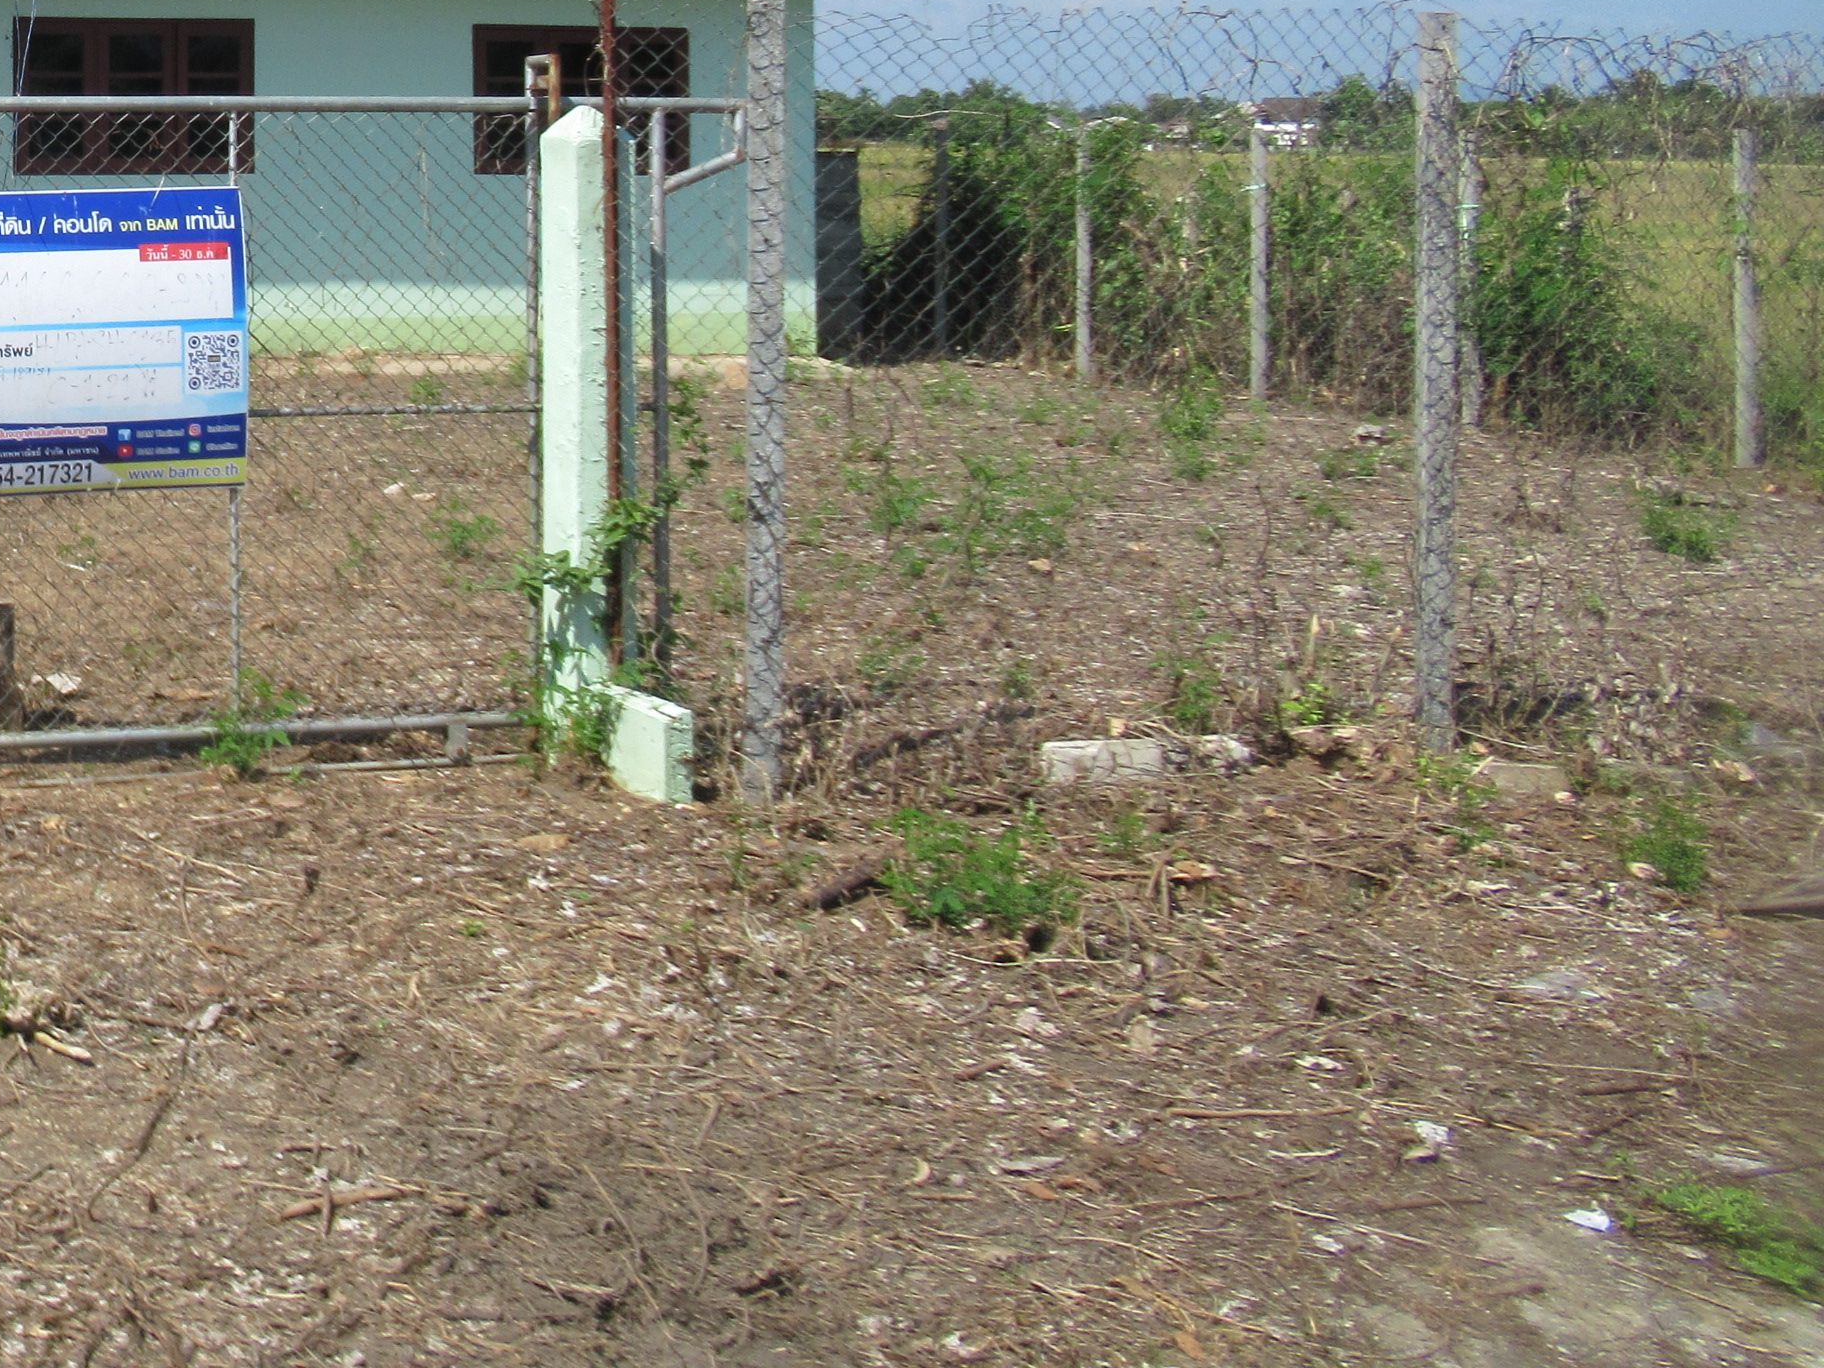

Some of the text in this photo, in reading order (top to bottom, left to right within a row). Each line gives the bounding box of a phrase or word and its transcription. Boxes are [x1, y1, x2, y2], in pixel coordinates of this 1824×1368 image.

[39, 216, 46, 234] /
[54, 211, 112, 234] คอนโด
[119, 220, 142, 231] จาก
[146, 218, 179, 231] BAM
[186, 205, 236, 230] เท่านั้น
[145, 244, 168, 260] วันนี้
[179, 249, 192, 259] 30
[128, 463, 238, 480] www.bam.co.th
